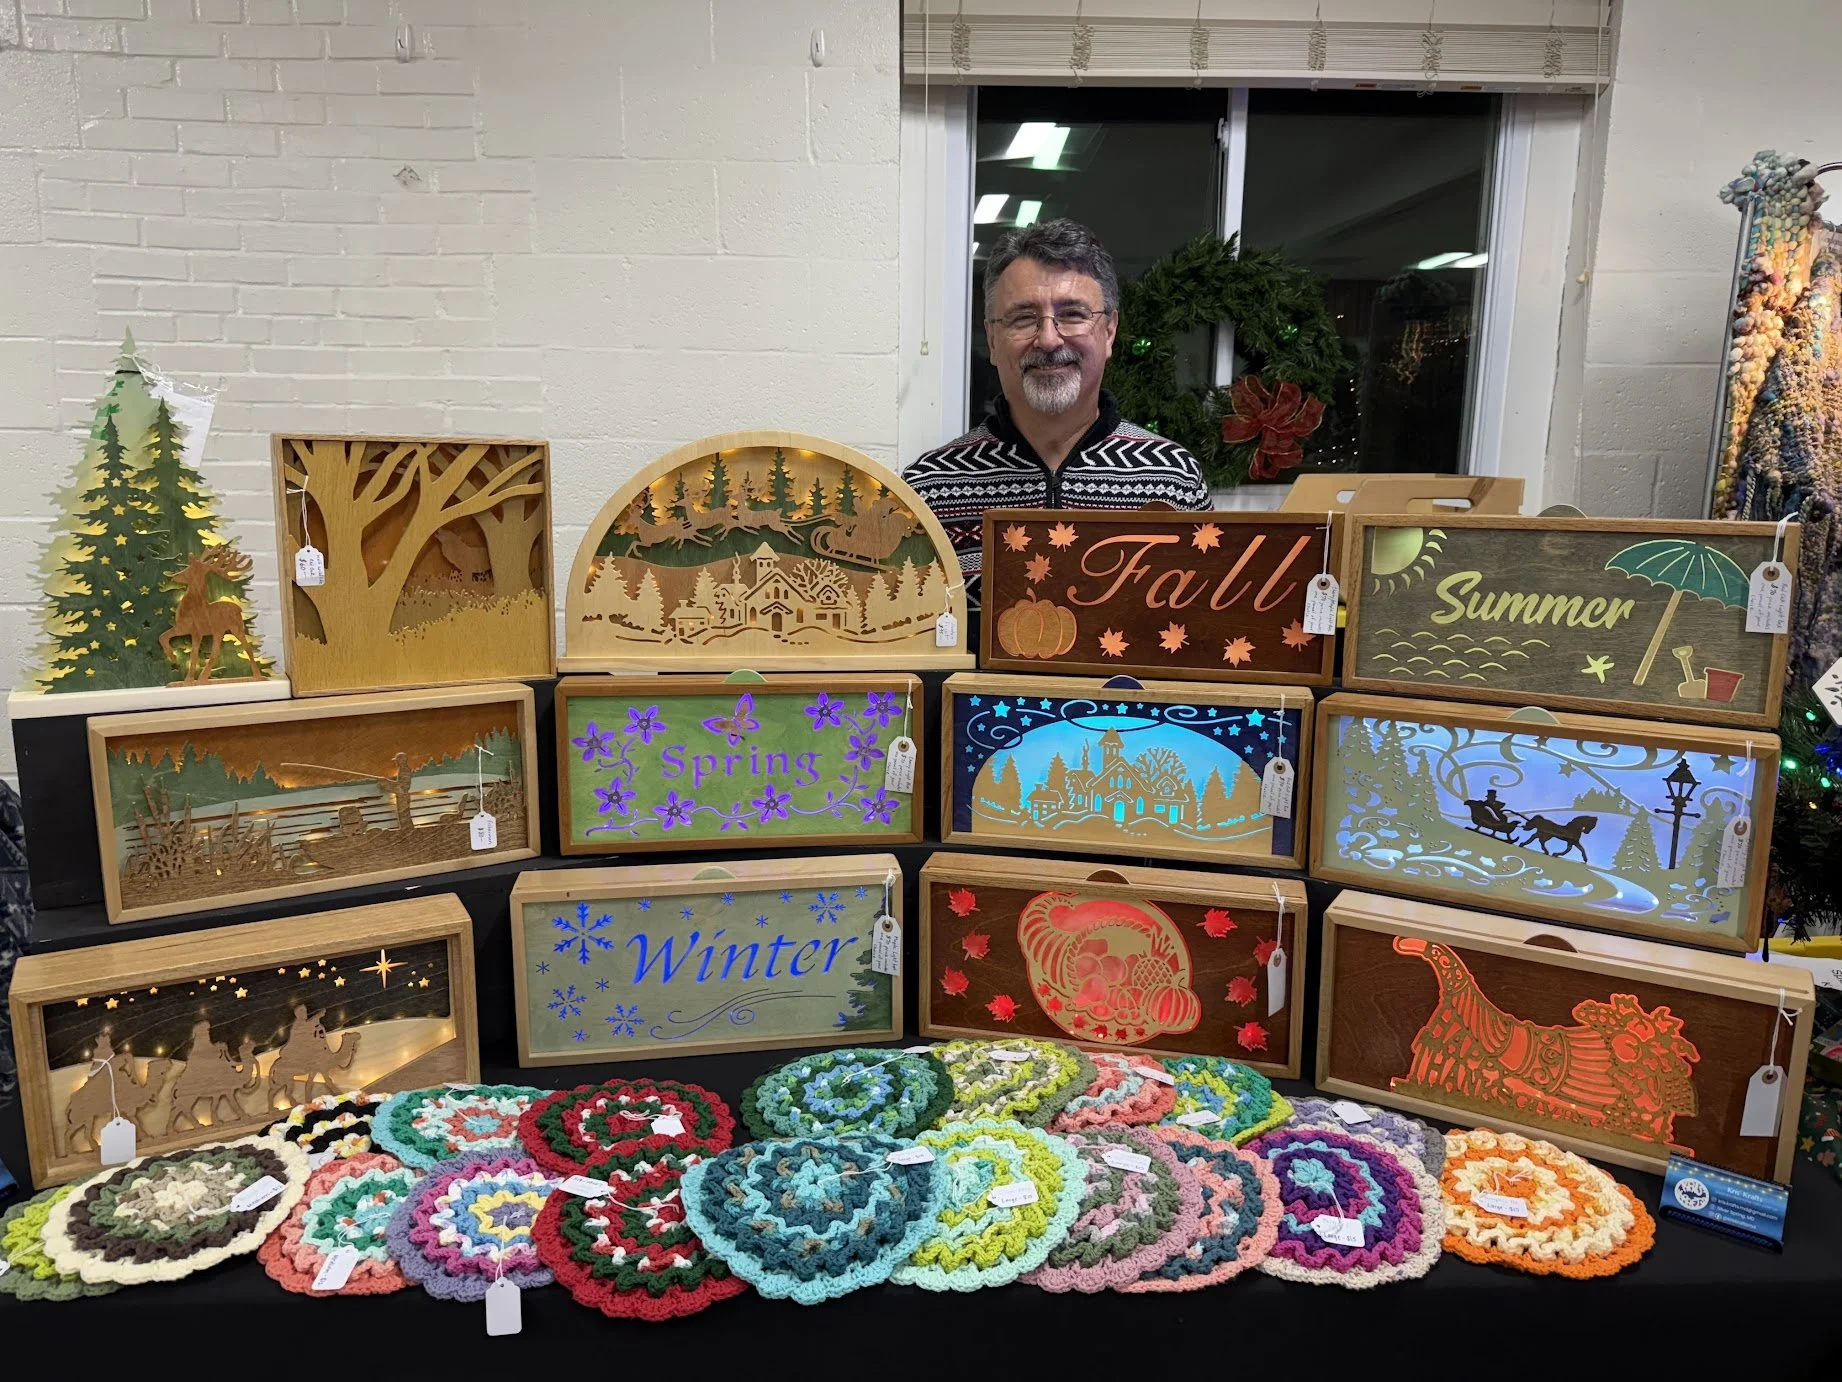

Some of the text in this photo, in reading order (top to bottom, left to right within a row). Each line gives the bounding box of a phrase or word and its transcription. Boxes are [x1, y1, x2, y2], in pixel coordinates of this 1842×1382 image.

[1066, 534, 1312, 612] Fall
[1430, 570, 1636, 630] Summer
[661, 744, 824, 789] Spring
[626, 928, 859, 985] Winter
